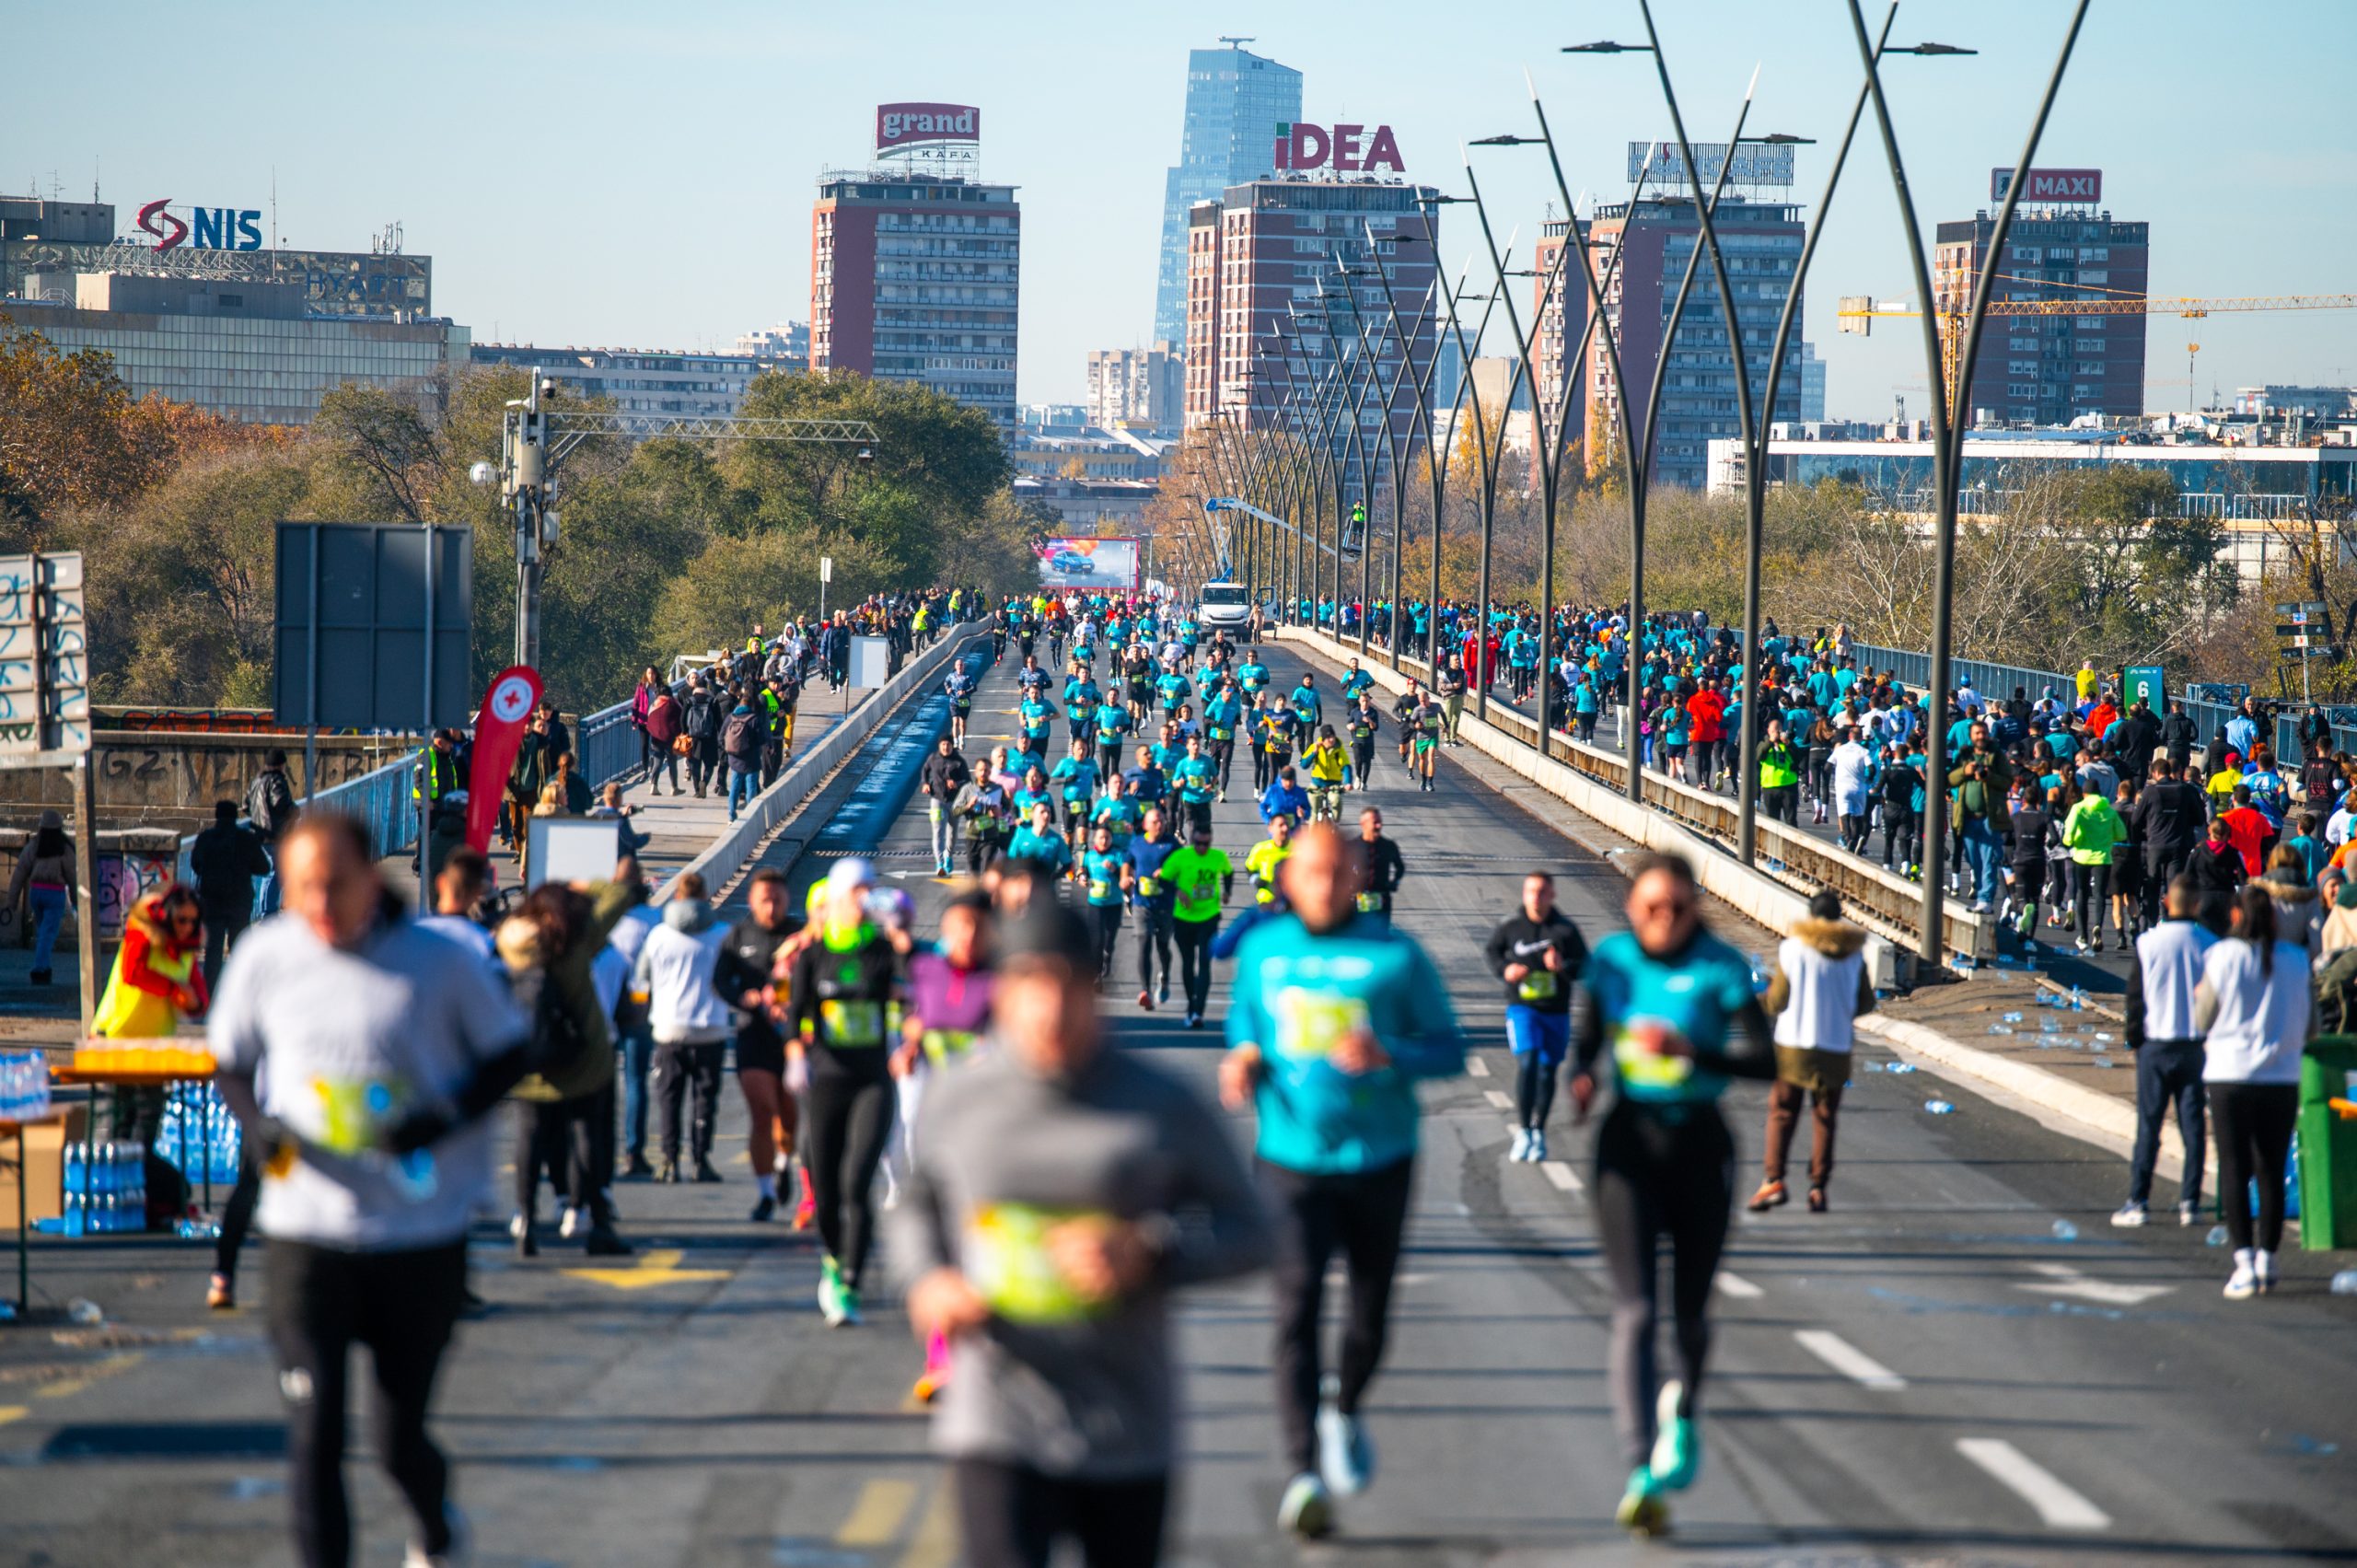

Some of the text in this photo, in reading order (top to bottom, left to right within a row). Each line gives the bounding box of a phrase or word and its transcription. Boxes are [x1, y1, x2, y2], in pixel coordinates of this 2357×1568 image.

[883, 109, 974, 139] grand
[922, 150, 971, 158] KAFA
[2035, 177, 2095, 195] MAXI
[193, 206, 262, 251] NIS
[306, 273, 408, 295] HYATT
[2137, 680, 2149, 698] 6
